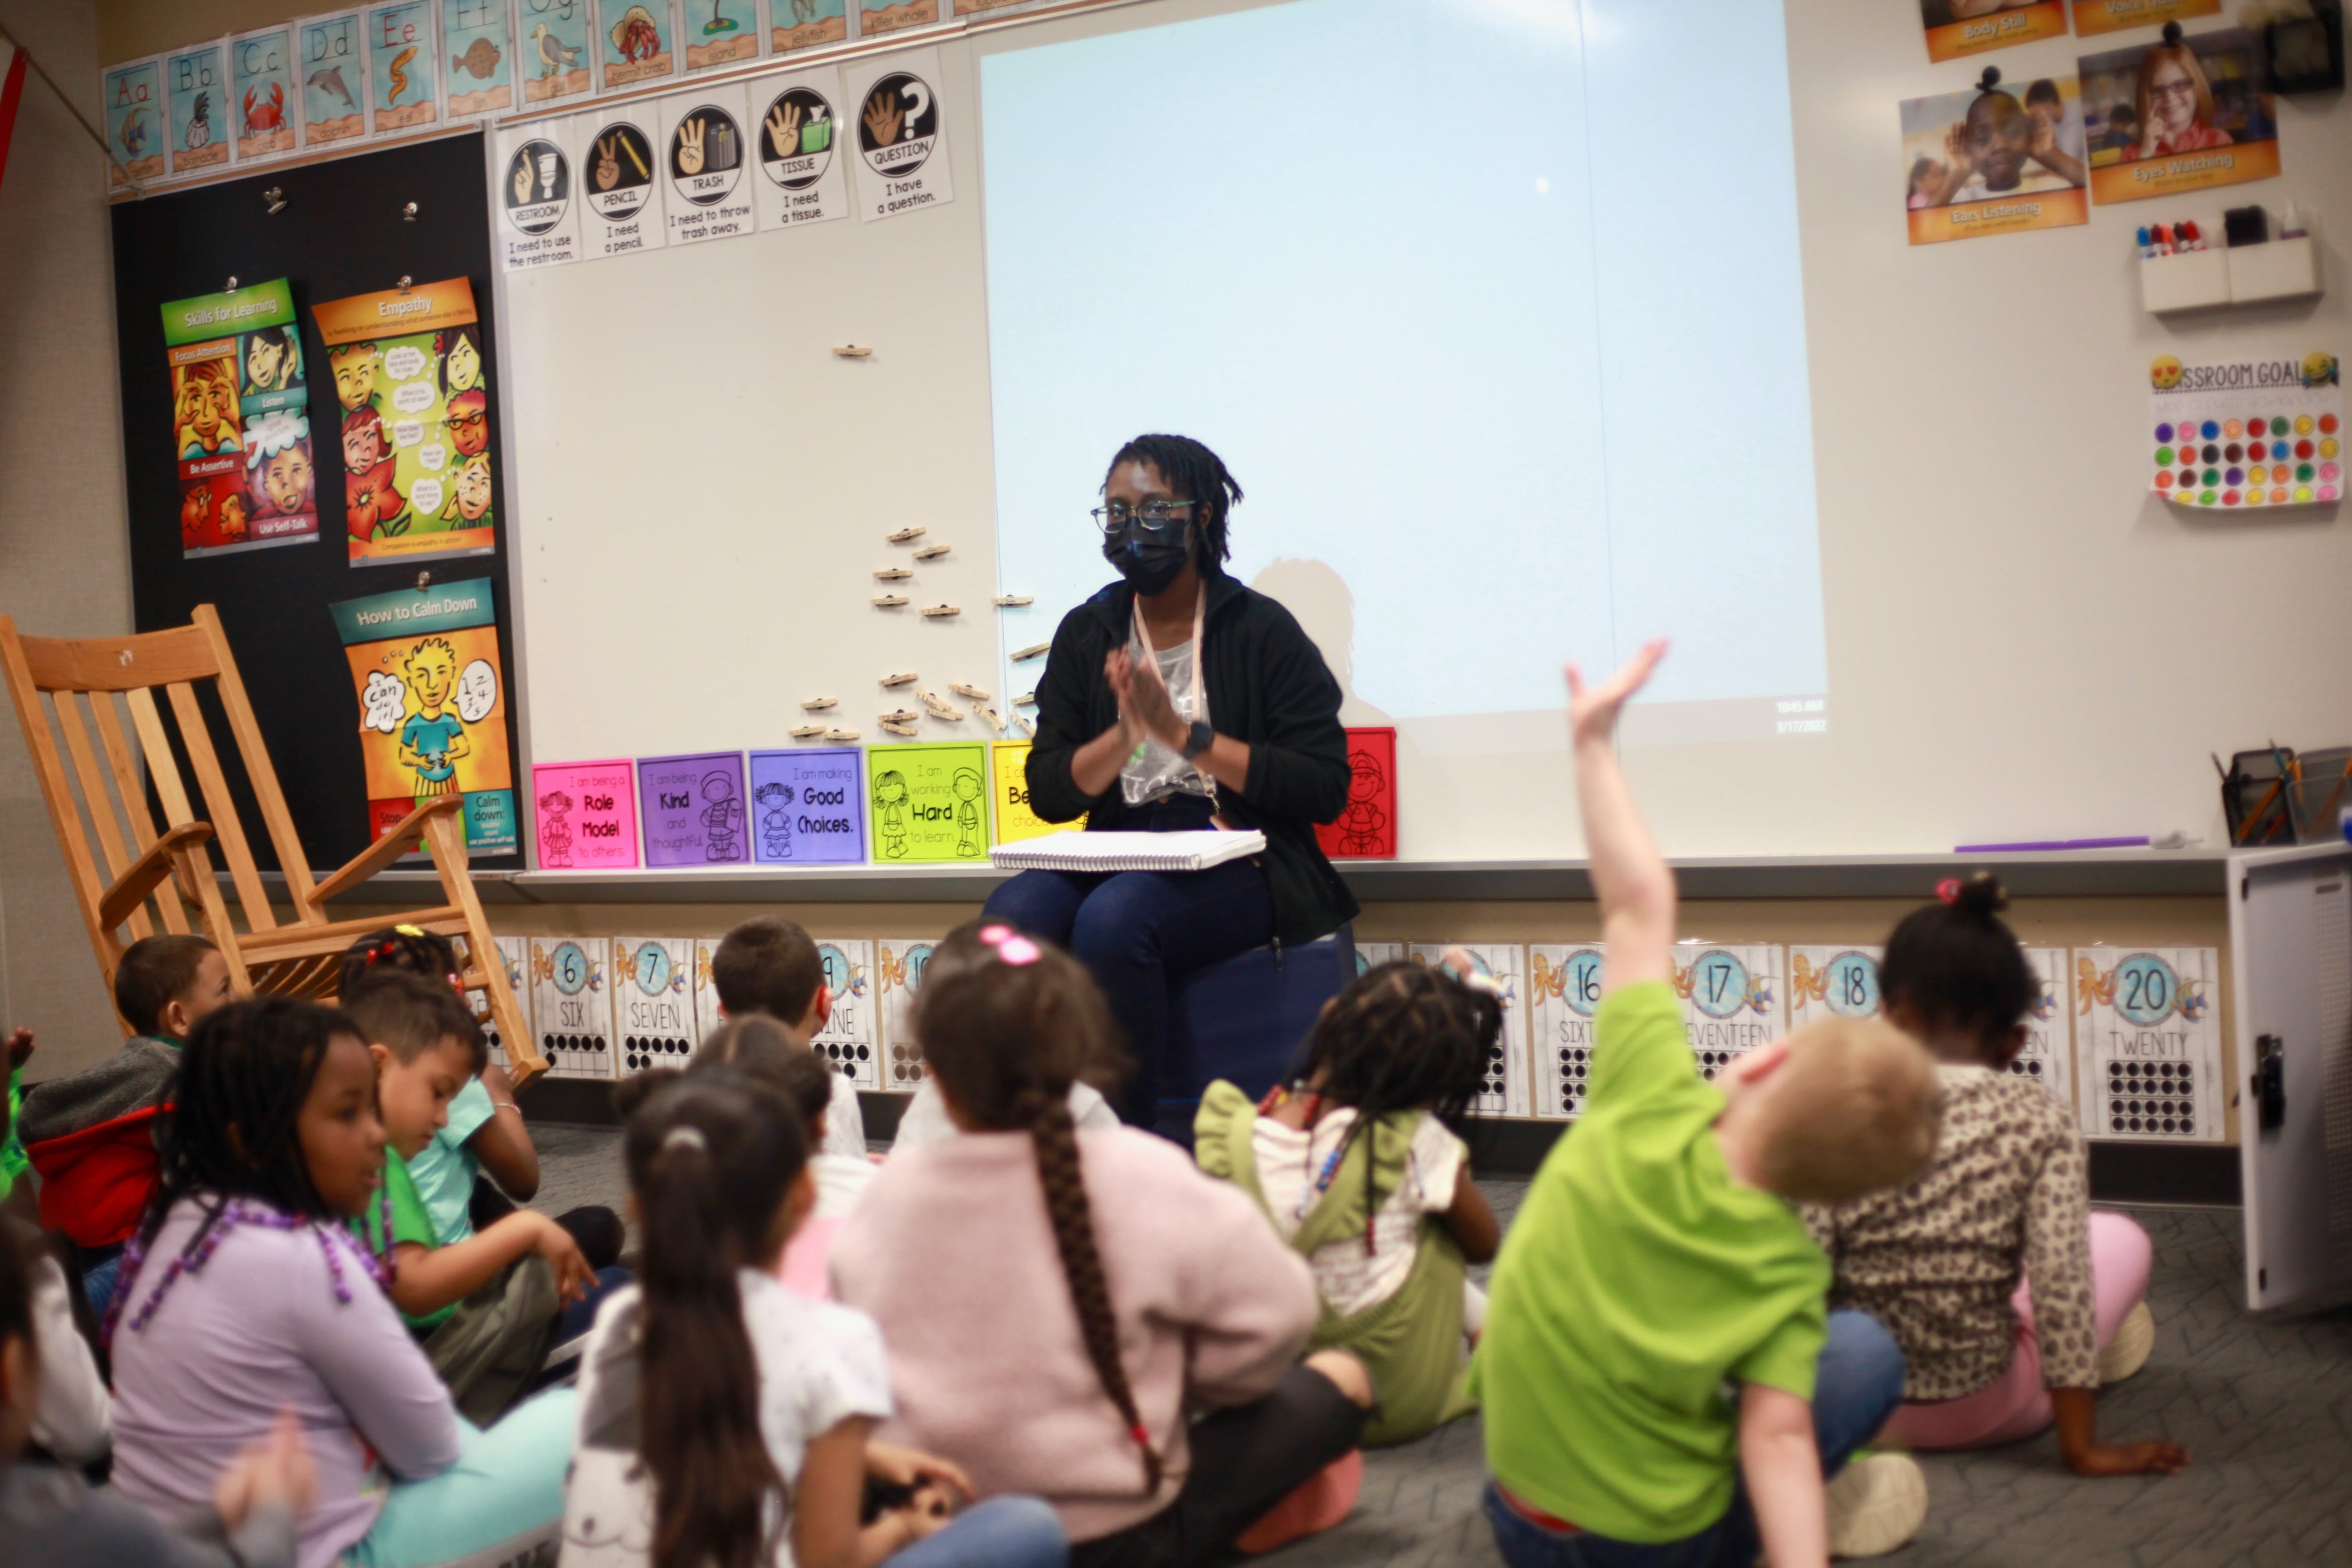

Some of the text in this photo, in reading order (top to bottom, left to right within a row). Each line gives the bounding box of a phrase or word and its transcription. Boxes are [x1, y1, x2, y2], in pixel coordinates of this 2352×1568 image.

[871, 8, 929, 30] killer whale
[1965, 13, 2026, 39] Body Still
[384, 14, 415, 47] Ee
[792, 27, 826, 46] jellyfish
[311, 23, 348, 61] Dd
[244, 44, 278, 74] Cc
[708, 48, 736, 62] island
[180, 57, 213, 91] Bb
[644, 63, 666, 75] crab
[118, 77, 148, 106] Aa
[874, 140, 930, 165] QUESTION
[781, 158, 815, 175] TISSUE
[2134, 166, 2164, 183] Eyes
[2168, 154, 2233, 175] Watching
[693, 175, 724, 191] TRASH
[886, 178, 922, 197] I have
[604, 191, 638, 207] PENCIL
[784, 191, 819, 208] I need
[878, 192, 936, 215] a question.
[516, 204, 560, 222] RESTROOM
[670, 205, 751, 227] I need to throw
[782, 207, 825, 224] a tissue.
[1952, 201, 2042, 223] Ears Listening
[607, 222, 639, 239] I need
[682, 223, 741, 240] trash away.
[509, 235, 571, 254] I need to use
[605, 236, 644, 254] a pencil.
[509, 250, 574, 269] the restroom.
[185, 298, 278, 328] Skills for Learning
[378, 296, 433, 317] Empathy
[175, 344, 231, 362] Focus Attention
[2152, 360, 2304, 390] SSROOM GOAL
[262, 396, 284, 408] Listen
[190, 458, 234, 474] Be Assertive
[259, 518, 308, 534] Use Self-Talk
[357, 597, 477, 626] How to Calm Down
[370, 684, 397, 702] can
[1805, 700, 1824, 712] AM
[648, 772, 697, 786] I am being
[793, 766, 852, 782] I am making
[917, 764, 943, 777] I am
[569, 777, 575, 788] I
[577, 778, 591, 788] am
[592, 775, 617, 788] being
[911, 782, 951, 798] working
[477, 795, 501, 808] Calm
[584, 795, 614, 812] Role
[660, 791, 690, 810] Kind
[803, 787, 844, 806] Good
[474, 810, 506, 821] down:
[912, 803, 953, 821] Hard
[582, 820, 620, 838] Model
[667, 820, 686, 830] and
[798, 815, 854, 835] Choices.
[652, 834, 704, 852] thoughtful.
[910, 830, 956, 843] to learn.
[579, 845, 627, 858] to others.
[564, 953, 576, 984] 6
[647, 954, 659, 984] 7
[823, 956, 834, 988] 9
[1578, 964, 1600, 1002] 16
[1708, 965, 1731, 1003] 17
[1845, 966, 1866, 1006] 18
[2125, 969, 2167, 1011] 20
[560, 1001, 584, 1027] SIX
[631, 1002, 681, 1029] SEVEN
[820, 1008, 854, 1035] INE
[1559, 1021, 1594, 1043] SIXT
[1686, 1023, 1772, 1046] EVENTEEN
[2109, 1032, 2189, 1056] TWENTY
